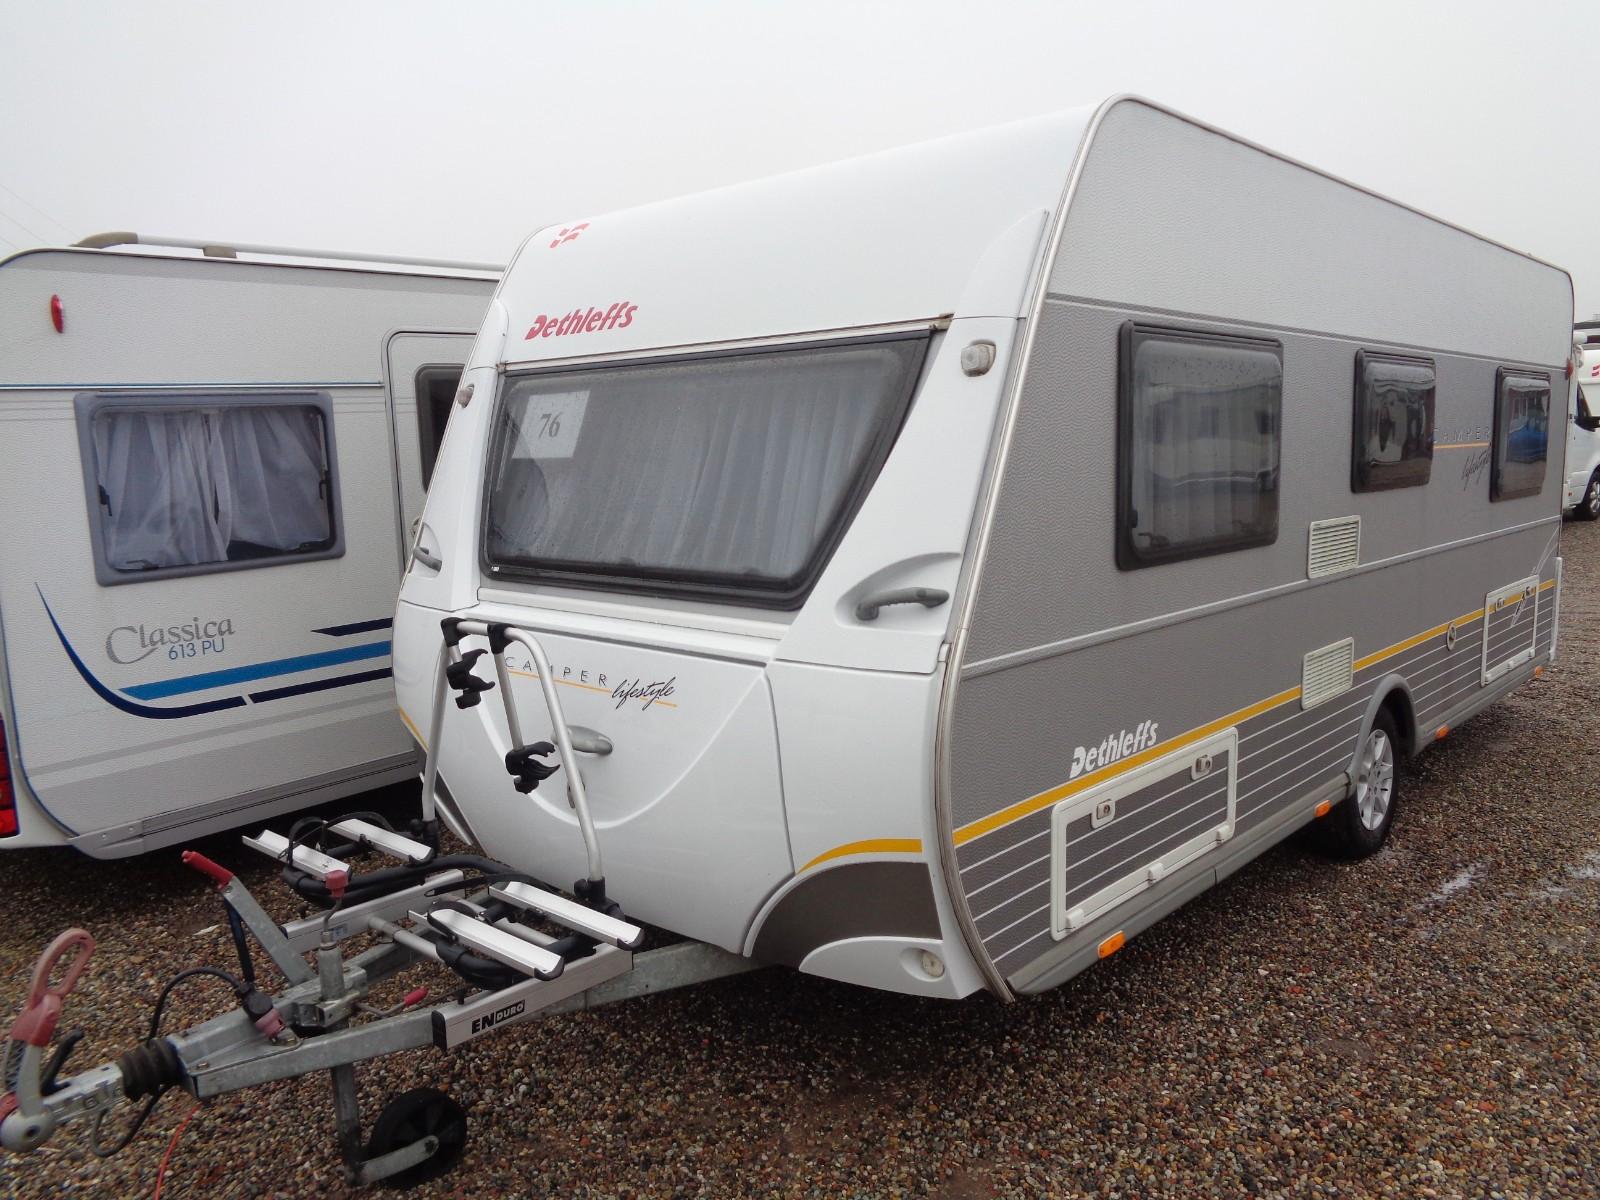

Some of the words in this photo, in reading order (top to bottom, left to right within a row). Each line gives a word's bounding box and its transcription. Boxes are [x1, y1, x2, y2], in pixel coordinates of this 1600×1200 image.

[525, 301, 638, 340] Dethleffs
[538, 411, 563, 438] 76
[106, 616, 235, 664] Classica
[168, 642, 196, 660] 613
[202, 638, 225, 655] PU
[505, 656, 607, 687] CAPER
[612, 677, 676, 711] lifestyle
[1069, 720, 1159, 779] Dethleffs
[472, 1000, 525, 1034] ENDURO
